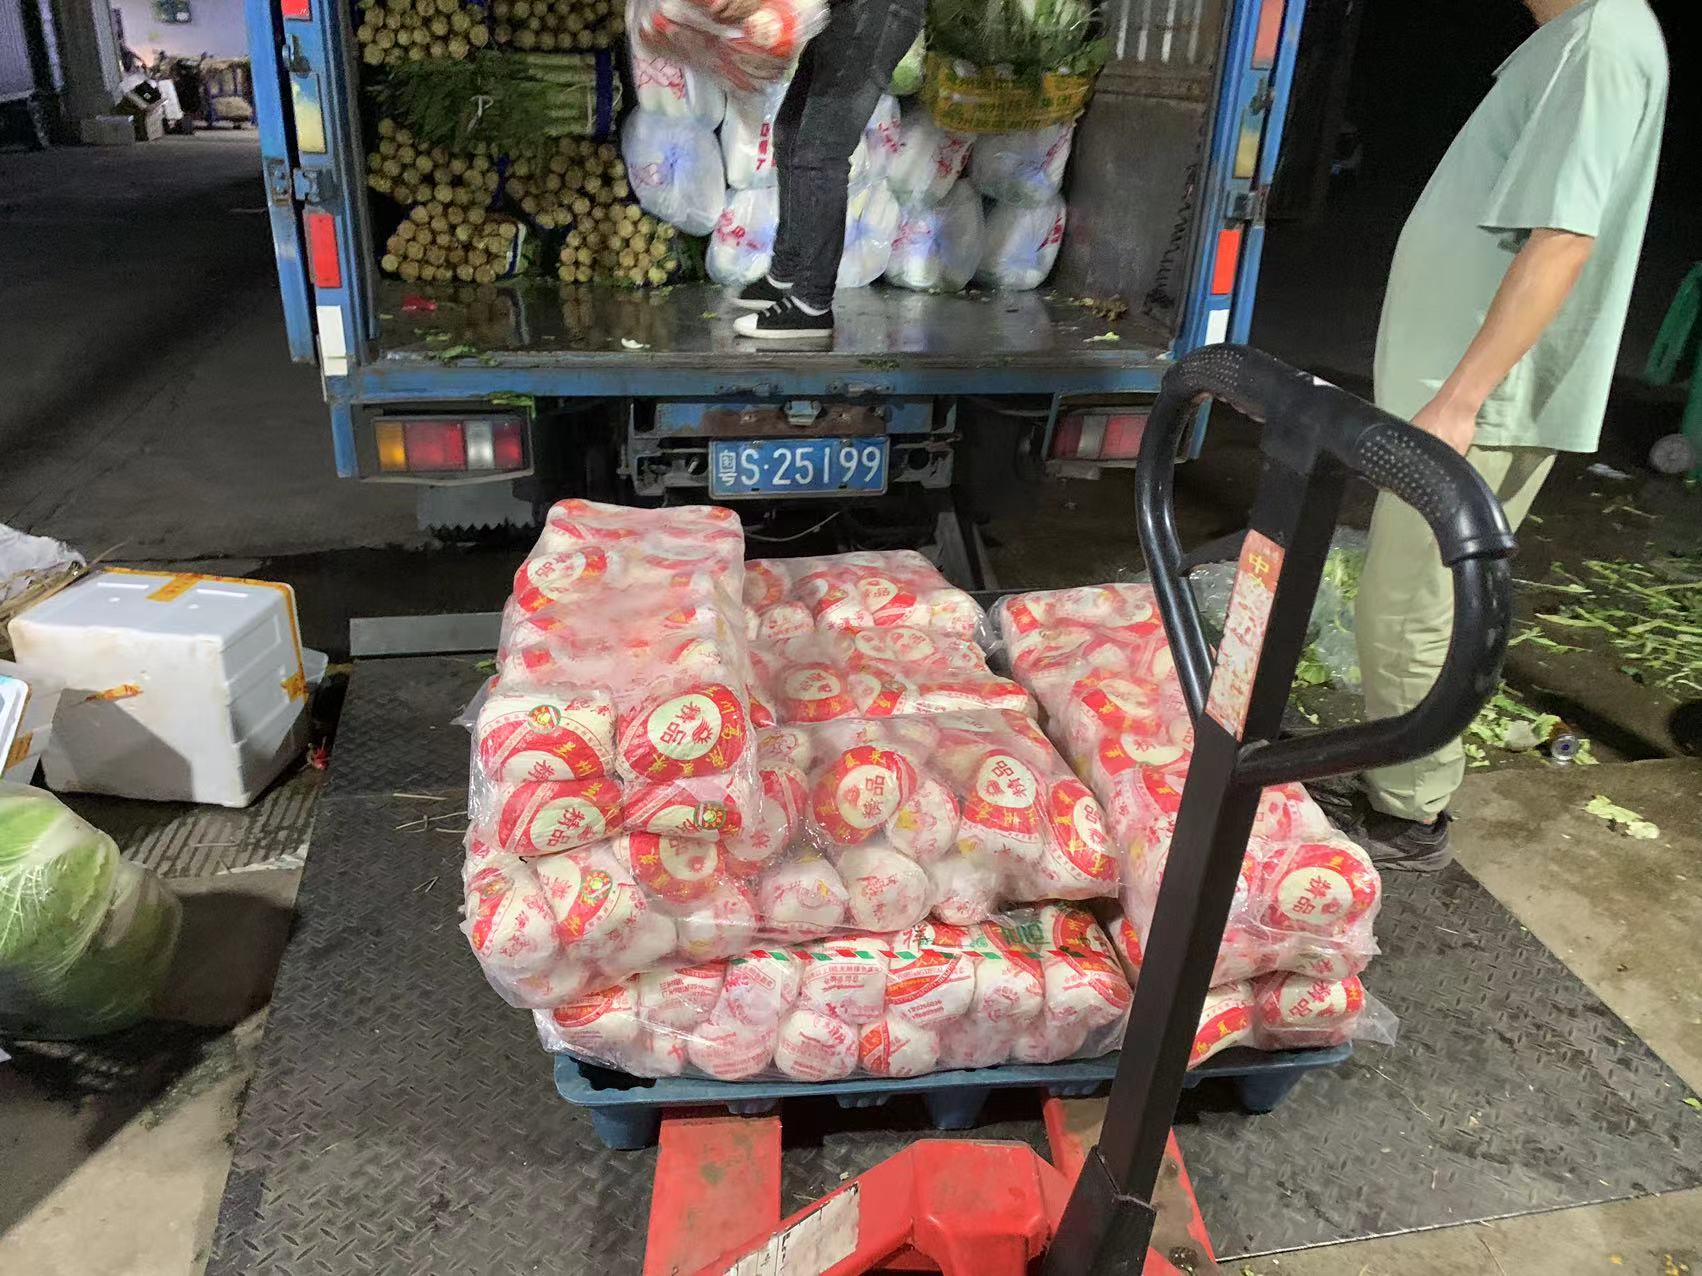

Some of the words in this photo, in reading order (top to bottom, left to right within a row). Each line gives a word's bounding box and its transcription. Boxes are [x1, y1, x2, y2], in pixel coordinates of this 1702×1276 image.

[660, 701, 701, 745] 精品
[991, 759, 1028, 799] 精品
[547, 807, 588, 848] 精品
[1293, 876, 1332, 915] 精品
[1289, 981, 1332, 1018] 精品
